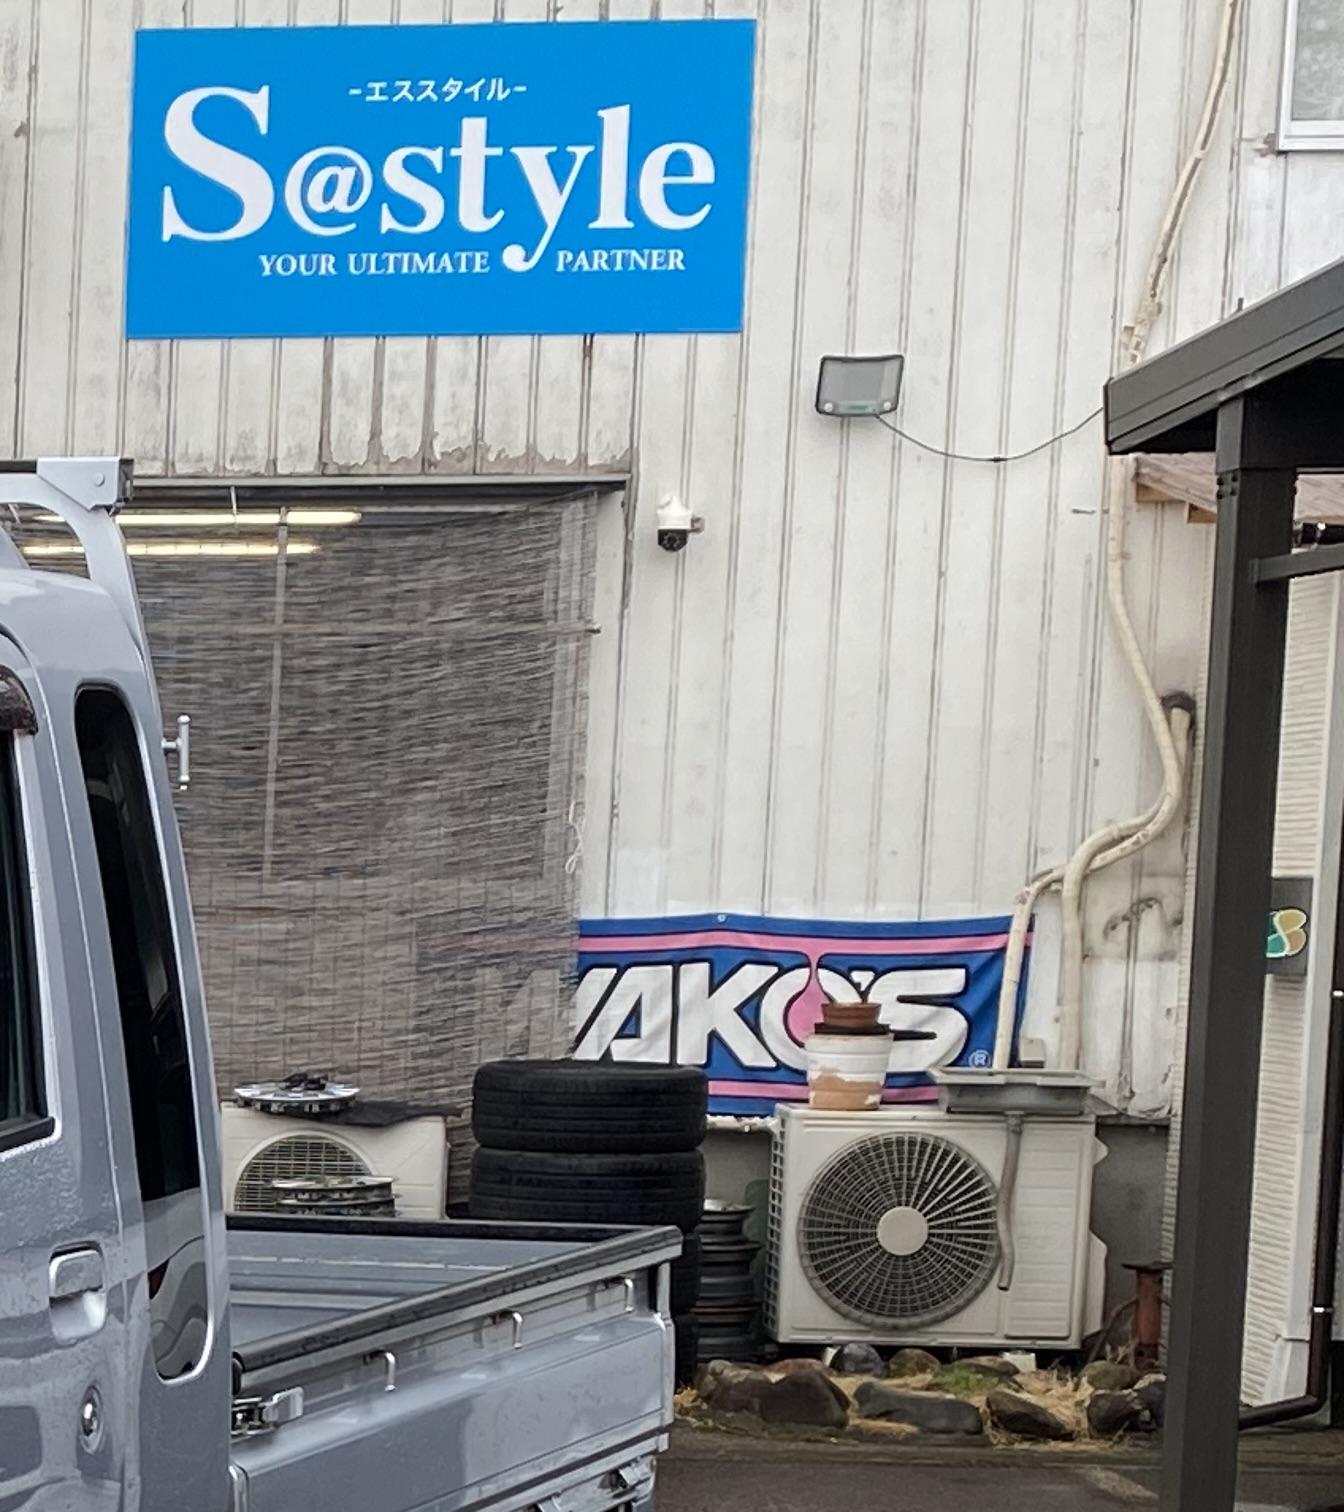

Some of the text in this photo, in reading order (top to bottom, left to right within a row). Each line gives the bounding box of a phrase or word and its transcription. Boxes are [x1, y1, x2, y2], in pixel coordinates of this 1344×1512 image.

[259, 249, 686, 277] YOUR ULTIMATE PARTNER
